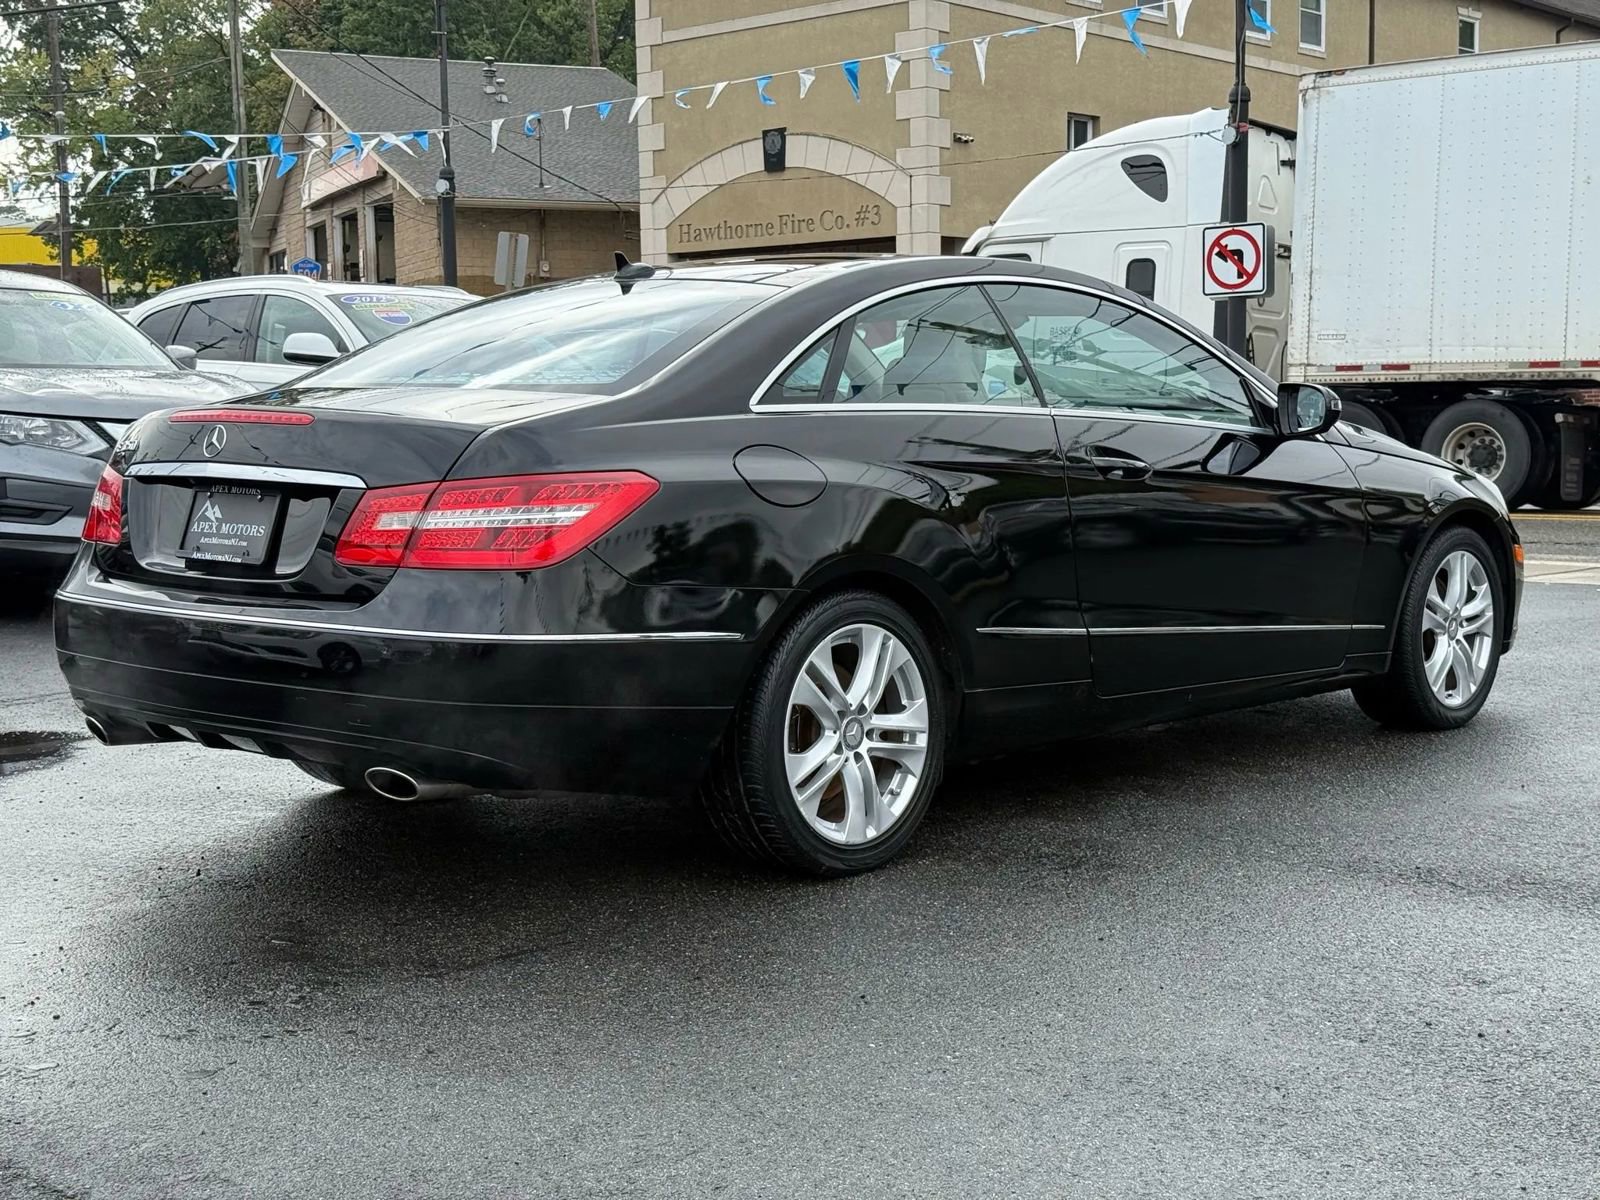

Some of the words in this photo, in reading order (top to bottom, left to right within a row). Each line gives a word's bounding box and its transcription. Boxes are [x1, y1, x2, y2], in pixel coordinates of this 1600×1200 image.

[678, 220, 775, 244] Hawthorne
[778, 213, 816, 236] Fire
[819, 209, 851, 231] Co.
[854, 204, 882, 228] #3
[352, 295, 387, 303] 2012
[210, 484, 229, 494] APEX
[230, 486, 261, 496] MOTORS
[191, 521, 219, 534] APEX
[219, 523, 266, 537] MOTORS
